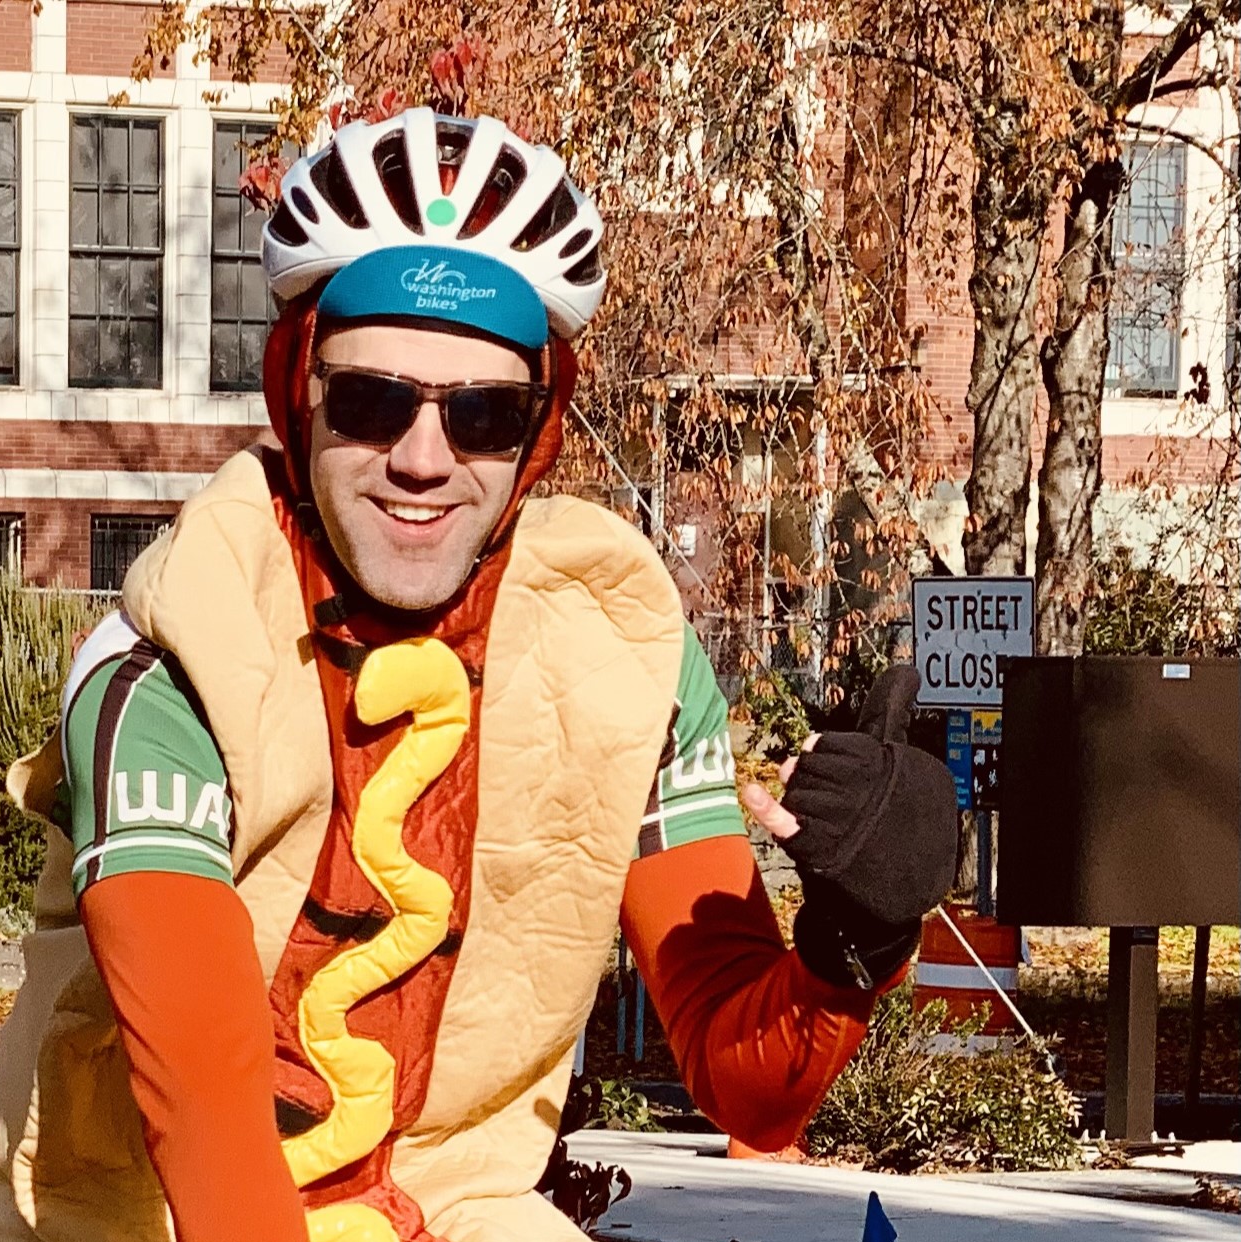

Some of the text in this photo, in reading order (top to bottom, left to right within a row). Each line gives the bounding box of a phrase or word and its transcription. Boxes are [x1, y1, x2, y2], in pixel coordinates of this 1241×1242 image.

[407, 282, 496, 301] washington
[415, 295, 458, 310] bikes
[927, 595, 1023, 633] STREET
[925, 652, 1006, 688] CLOSE
